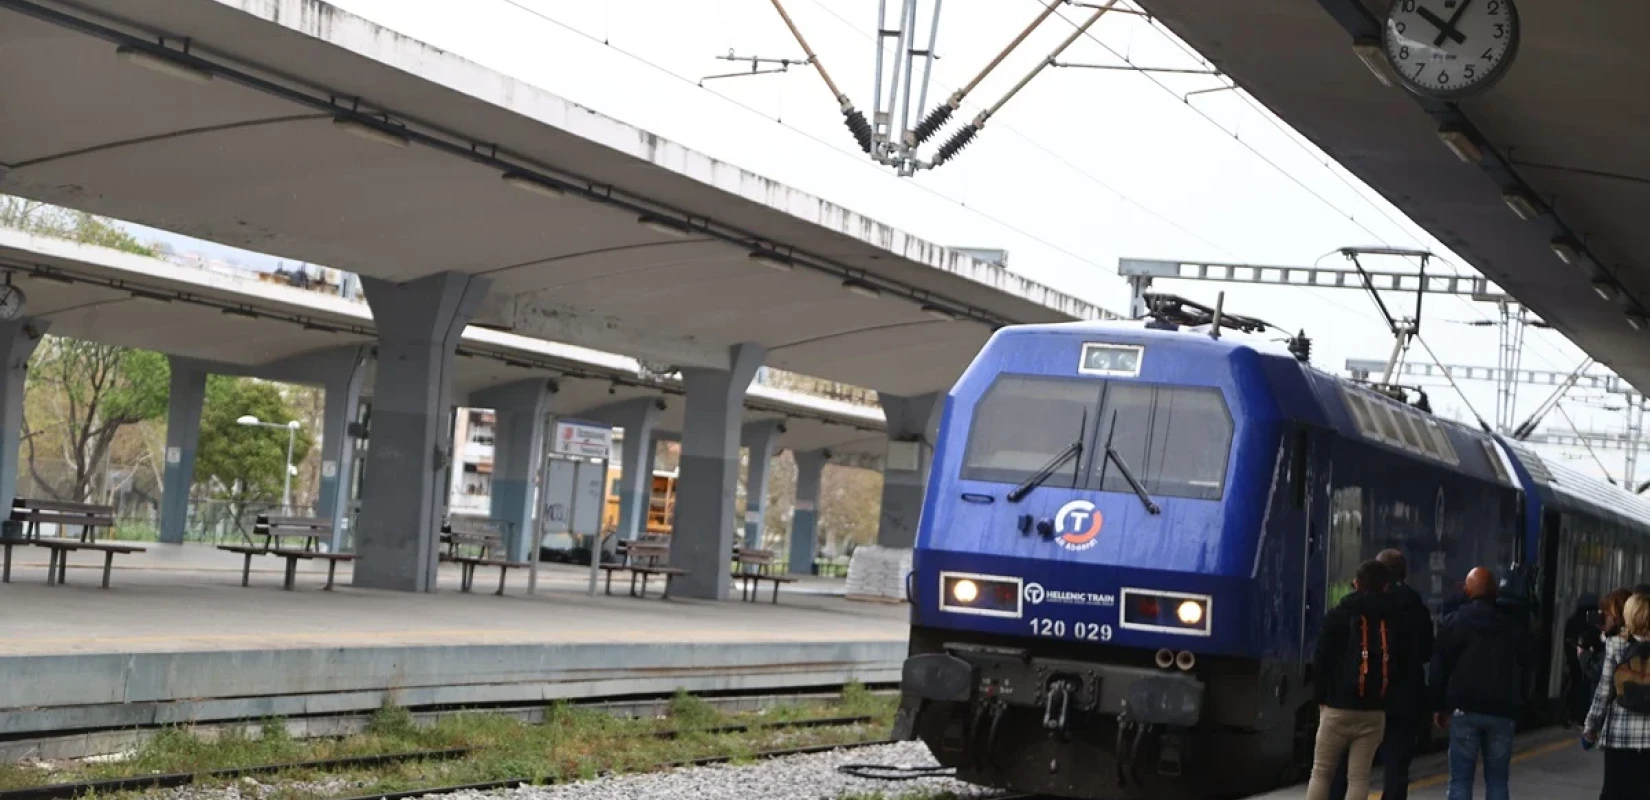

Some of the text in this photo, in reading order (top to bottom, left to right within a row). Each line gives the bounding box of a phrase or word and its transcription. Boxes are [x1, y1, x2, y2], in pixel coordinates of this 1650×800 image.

[1401, 0, 1415, 13] 10
[1487, 1, 1499, 15] 2
[1395, 22, 1406, 35] 9
[1493, 23, 1504, 39] 3
[1399, 46, 1409, 60] 8
[1481, 47, 1493, 62] 4
[1413, 63, 1426, 80] 7
[1437, 69, 1449, 84] 6
[1463, 64, 1475, 79] 5
[1046, 590, 1086, 600] HELLENIC
[1087, 594, 1115, 603] TRAIN
[1030, 618, 1112, 641] 120 029
